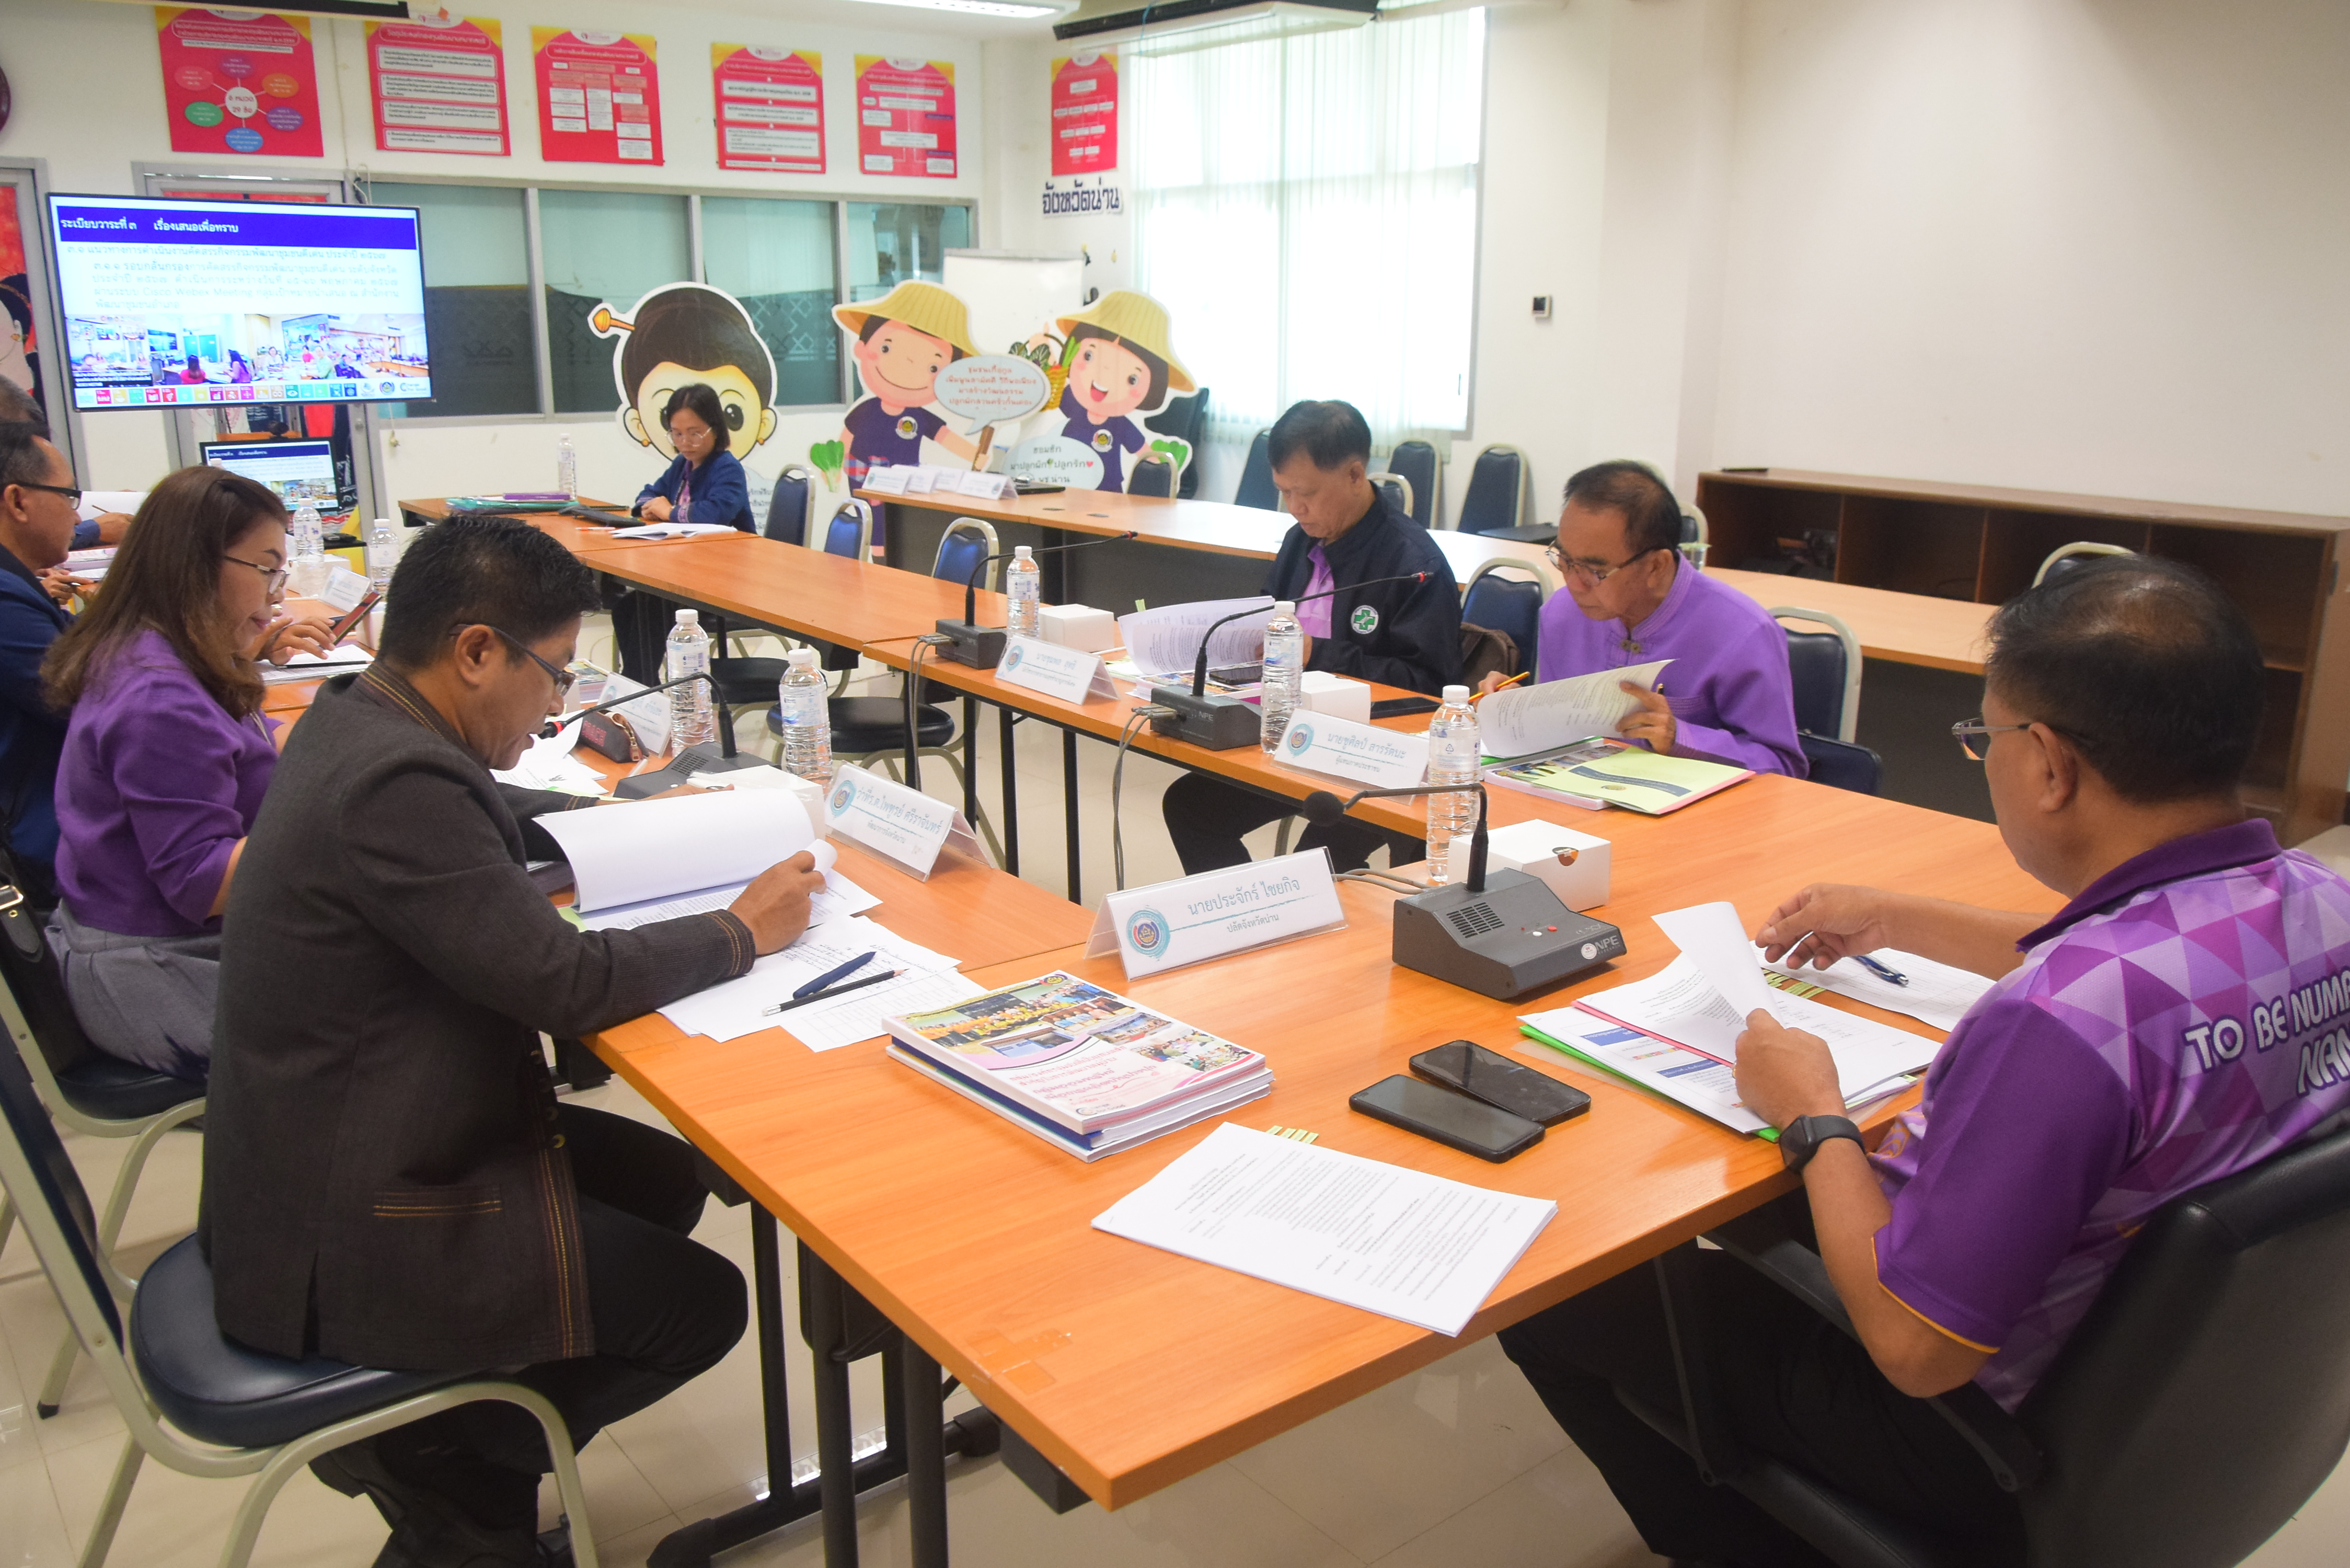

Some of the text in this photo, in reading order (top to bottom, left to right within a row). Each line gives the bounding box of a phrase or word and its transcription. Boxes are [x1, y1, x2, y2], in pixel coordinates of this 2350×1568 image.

[1042, 176, 1120, 214] จังหวัดน่าน
[61, 216, 127, 229] ระเบียบวาระที่
[154, 217, 239, 233] เรื่องเสนอเพื่อทราบ
[143, 288, 171, 296] Cisco
[175, 289, 209, 297] Webex
[213, 289, 253, 298] Meeting
[1199, 711, 1214, 722] NPE
[1328, 733, 1407, 759] นายชูศิลป์ สารรัตนะ
[1335, 756, 1381, 773] ผู้แทนภาคประชาชน
[1187, 876, 1300, 916] นายประจักร์ ไชยกิจ
[1227, 913, 1280, 933] ปลัดจังหวัดน่าน
[1595, 935, 1619, 951] NPE
[2185, 1018, 2244, 1070] TO
[2253, 999, 2288, 1049] BE
